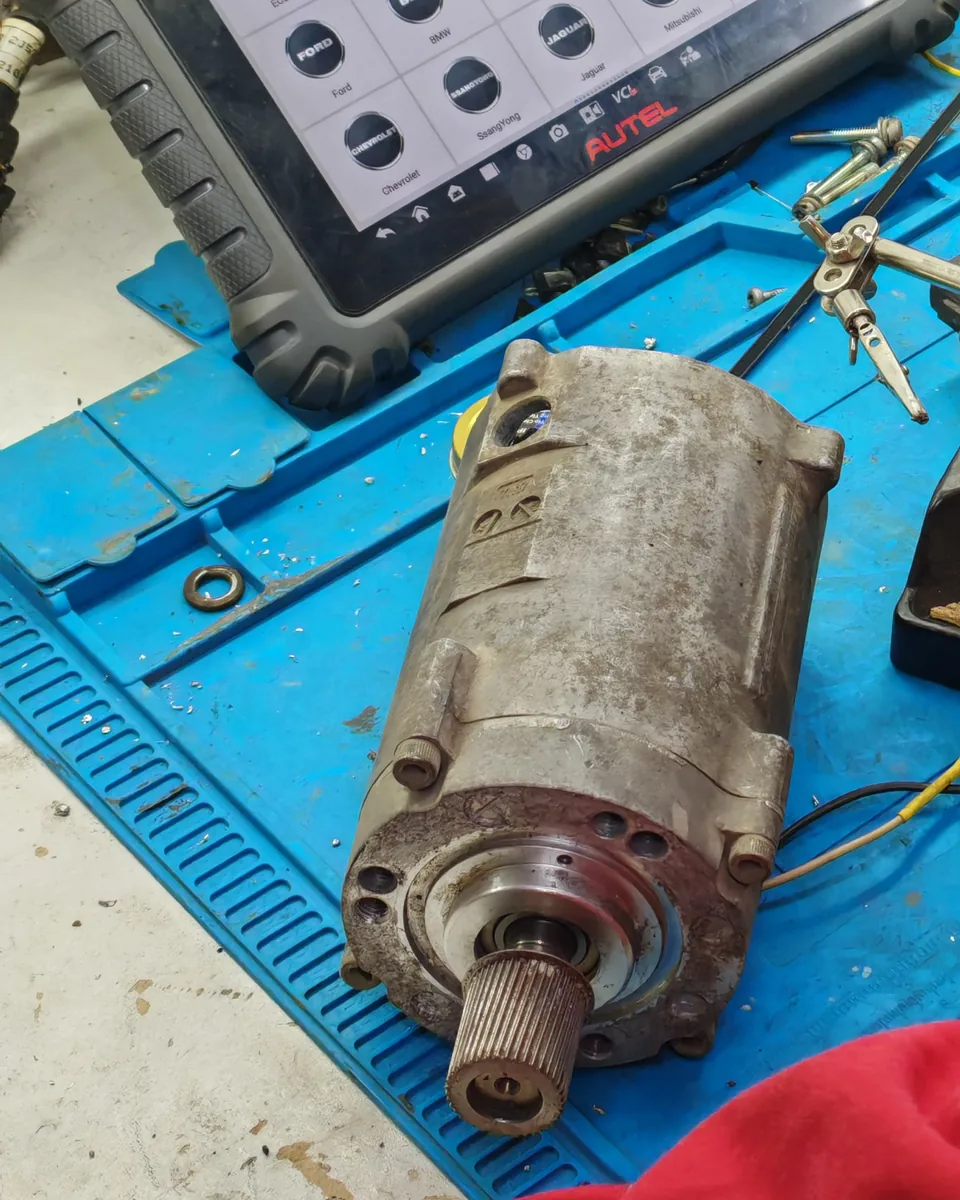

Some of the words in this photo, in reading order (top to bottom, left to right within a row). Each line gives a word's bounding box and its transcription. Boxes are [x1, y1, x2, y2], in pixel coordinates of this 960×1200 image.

[546, 17, 589, 46] JAGUAR
[663, 6, 703, 32] Mitsubishi
[296, 37, 334, 62] FORD
[428, 27, 452, 45] BMW
[450, 71, 495, 99] SSANGYONG
[581, 63, 606, 81] Jaguar
[331, 82, 353, 98] Ford
[476, 112, 522, 140] SsangYong
[585, 100, 679, 163] AUTEL
[350, 125, 397, 156] CHEVROLET
[381, 169, 421, 196] Chevrolet
